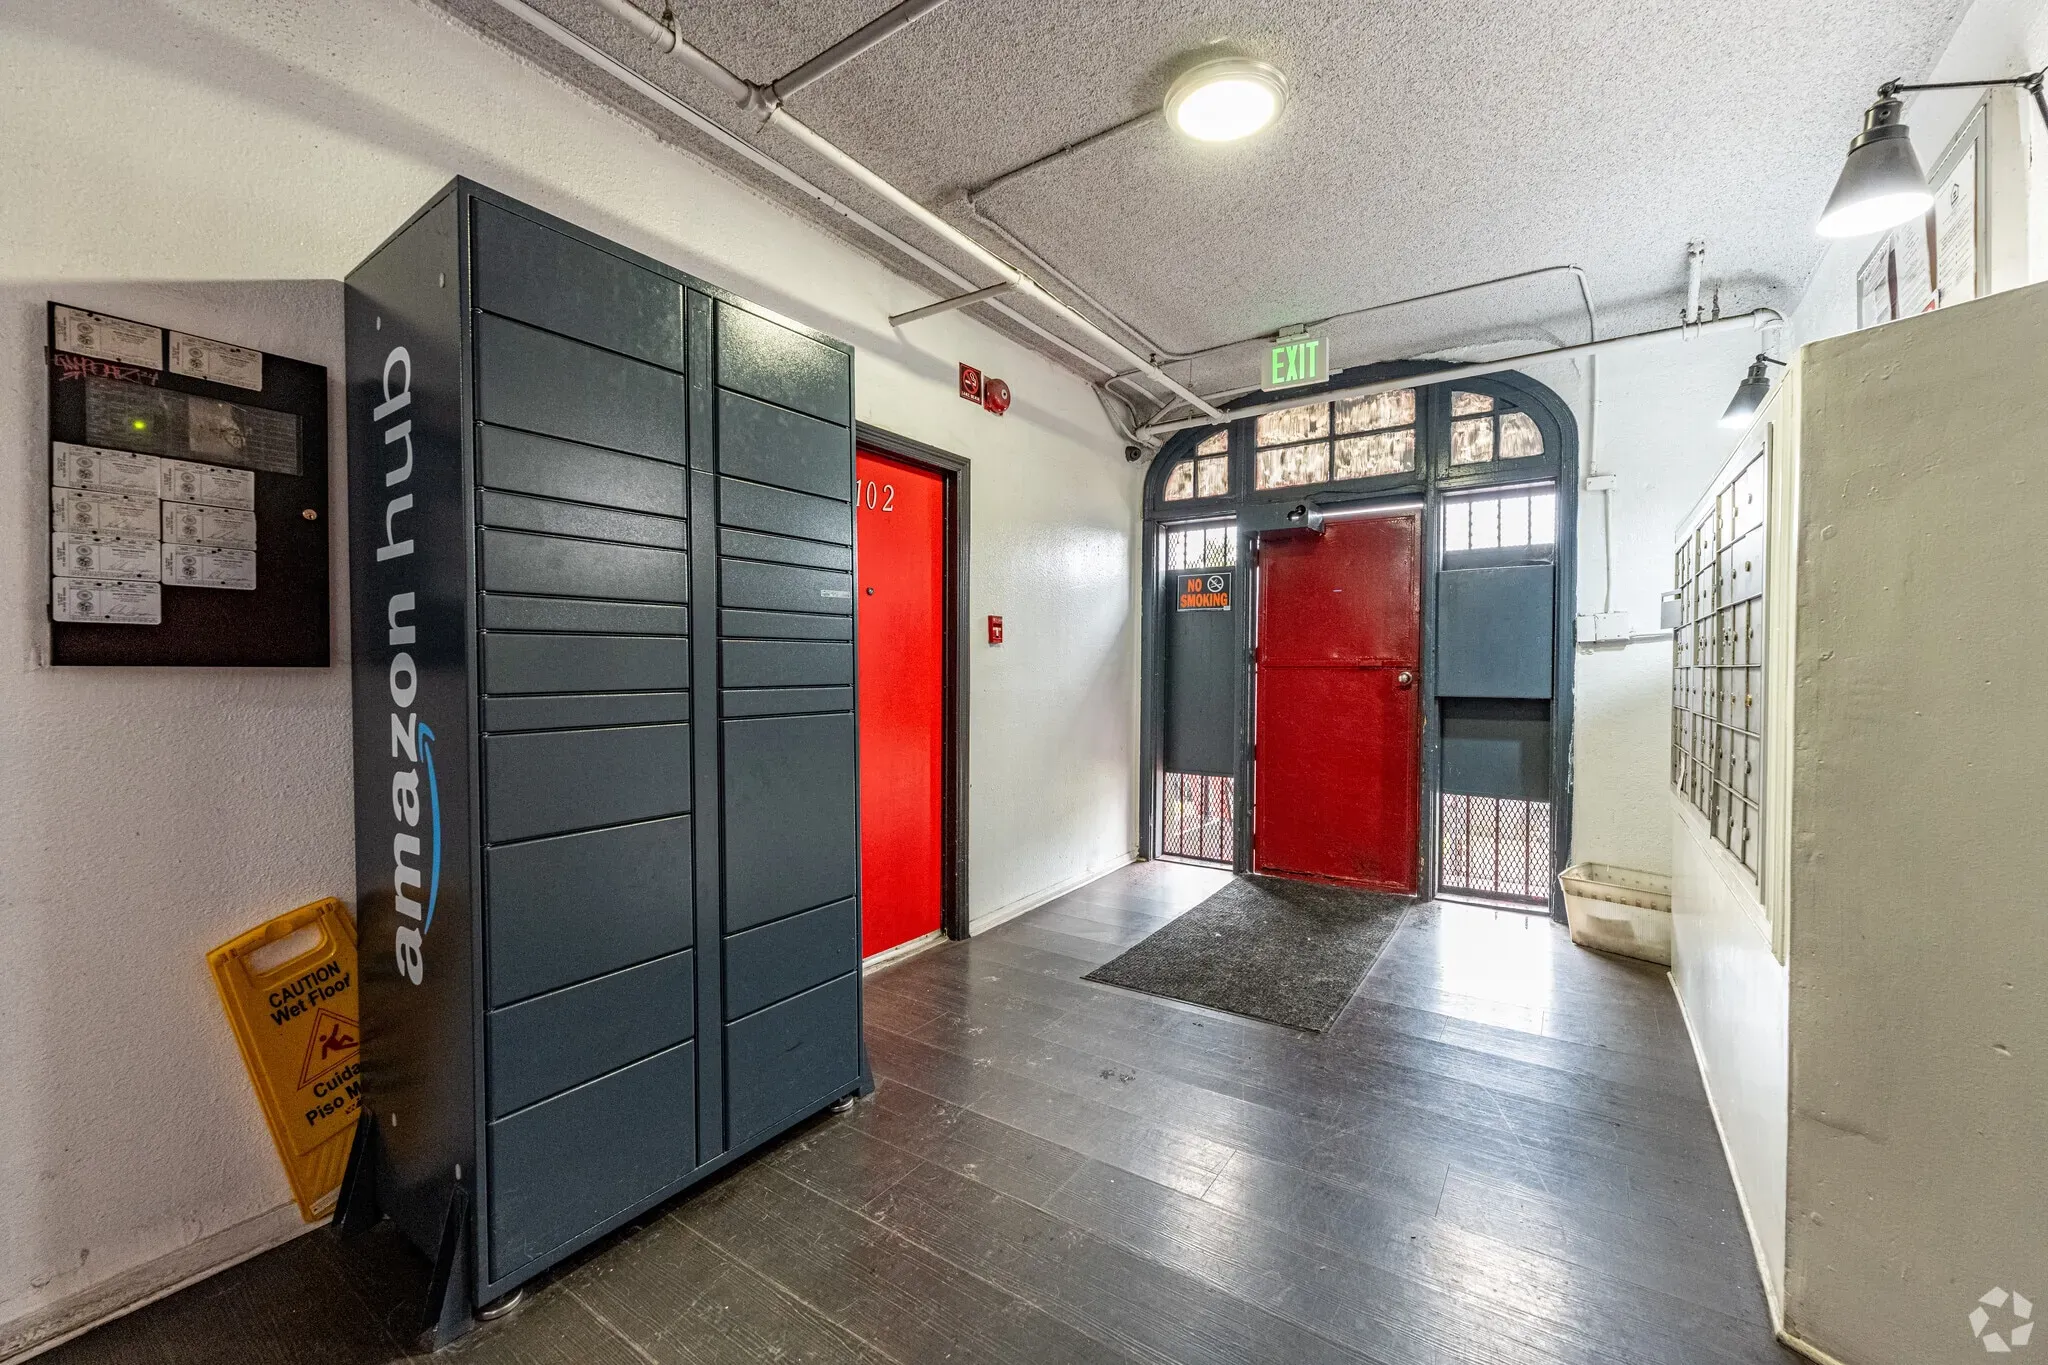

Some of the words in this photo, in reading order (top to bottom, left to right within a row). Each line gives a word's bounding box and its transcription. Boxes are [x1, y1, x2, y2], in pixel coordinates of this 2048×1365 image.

[1272, 341, 1319, 384] EXIT
[373, 346, 415, 563] hub
[856, 479, 895, 512] 102
[1180, 592, 1229, 608] SMOKING
[1187, 578, 1203, 593] NO
[388, 591, 424, 985] amazon
[269, 961, 341, 1008] CAUTION
[270, 999, 308, 1026] Wet
[308, 972, 351, 1007] Floor
[313, 1063, 361, 1098] Cuida
[305, 1096, 345, 1127] Piso
